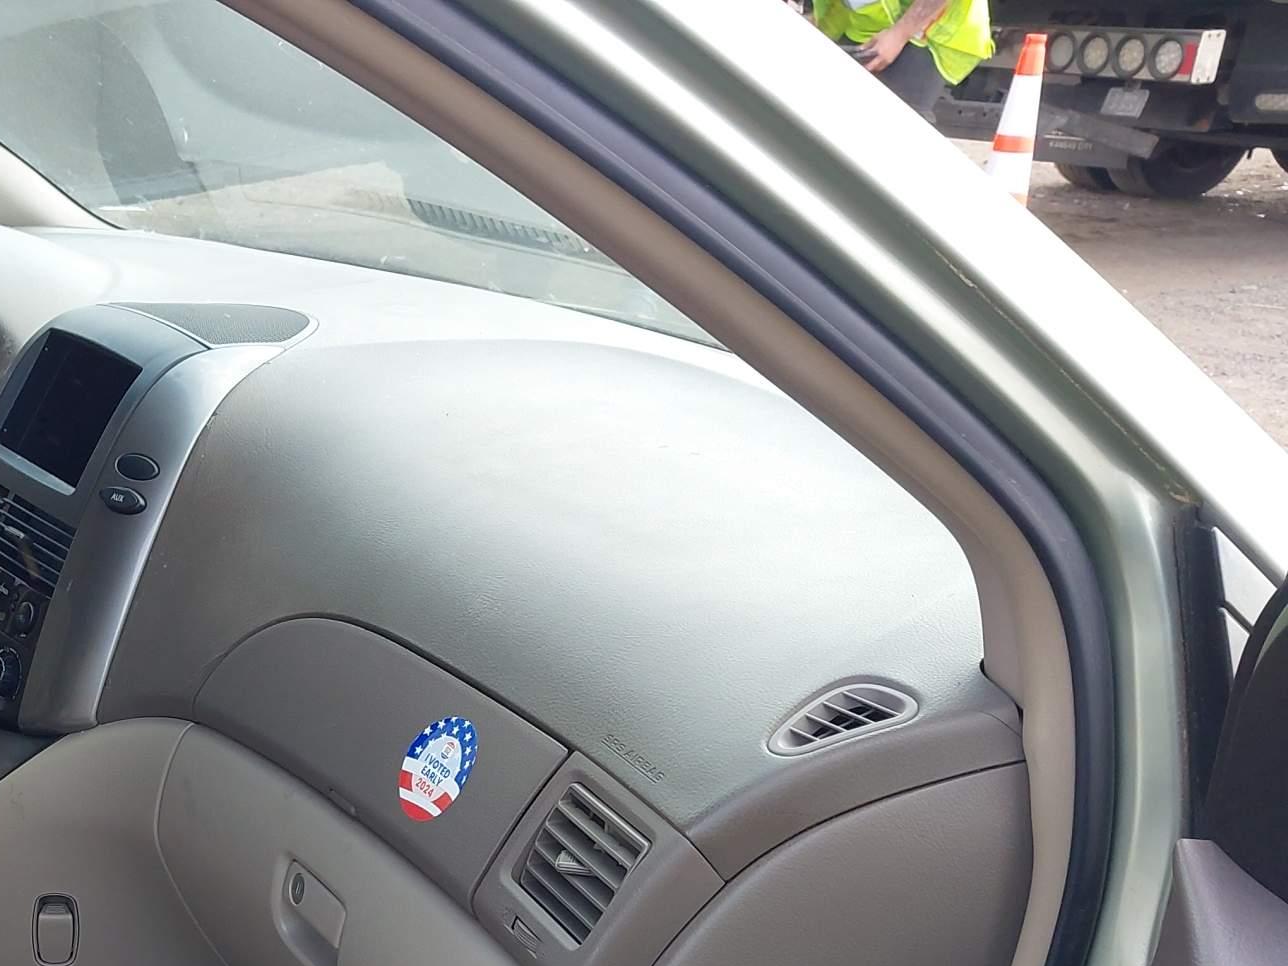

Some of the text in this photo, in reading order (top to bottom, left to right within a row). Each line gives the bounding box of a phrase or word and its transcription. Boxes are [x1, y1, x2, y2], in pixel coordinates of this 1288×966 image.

[421, 765, 443, 787] EARLY
[424, 752, 451, 778] I VOTED
[623, 750, 665, 781] AIRBAG
[415, 777, 434, 797] 2024
